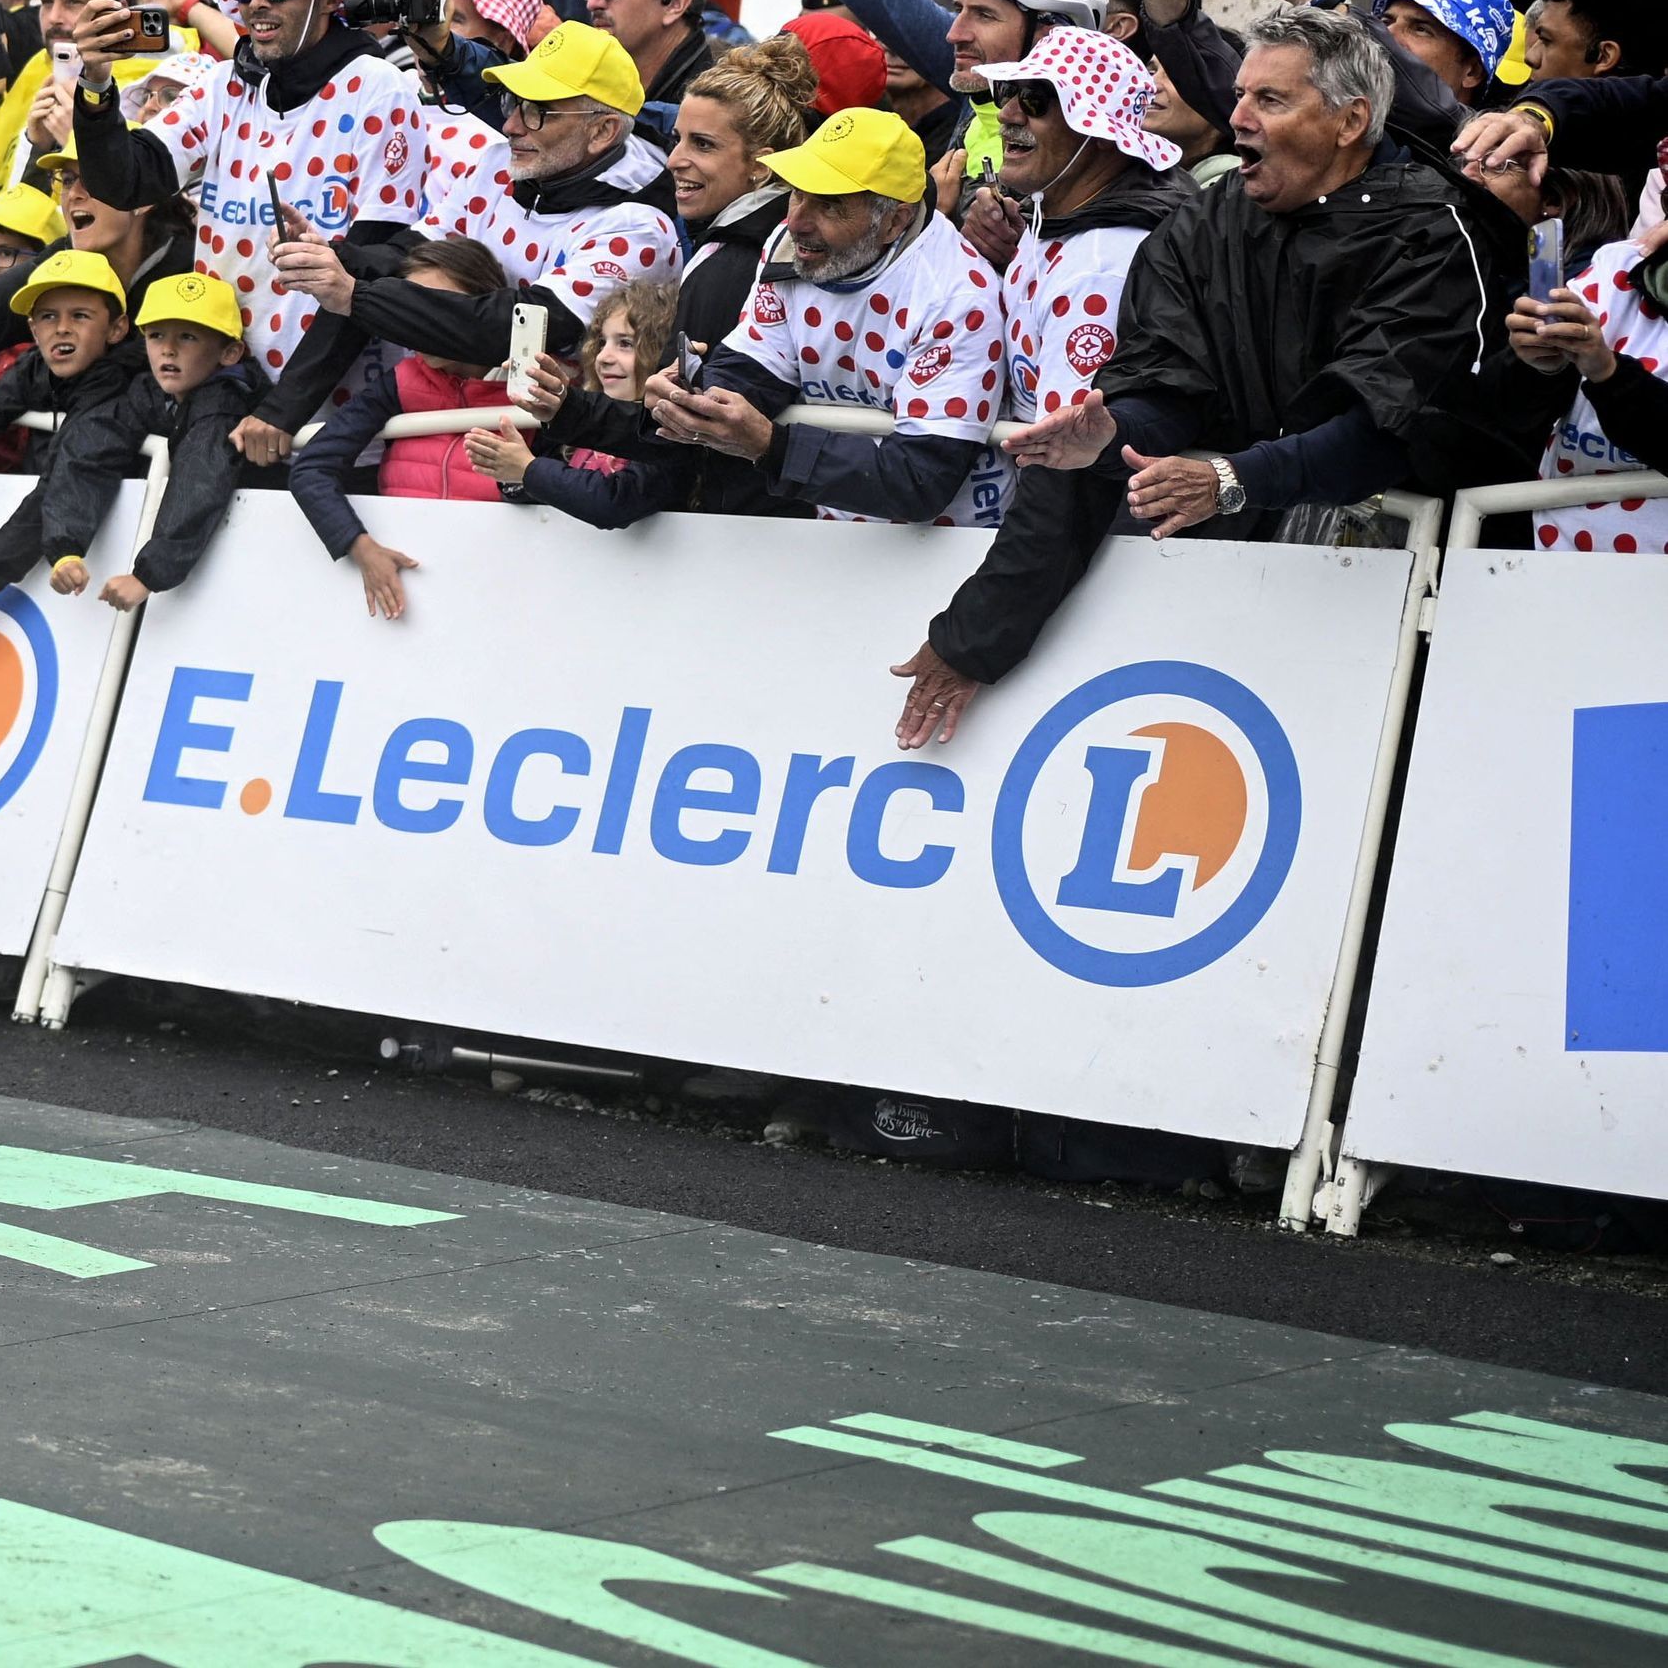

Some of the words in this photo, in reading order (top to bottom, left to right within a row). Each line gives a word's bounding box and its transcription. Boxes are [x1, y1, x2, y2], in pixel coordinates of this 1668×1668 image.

[1070, 323, 1113, 343] MARQUE
[142, 665, 967, 890] E.Leclerc
[898, 1104, 930, 1125] Isigny
